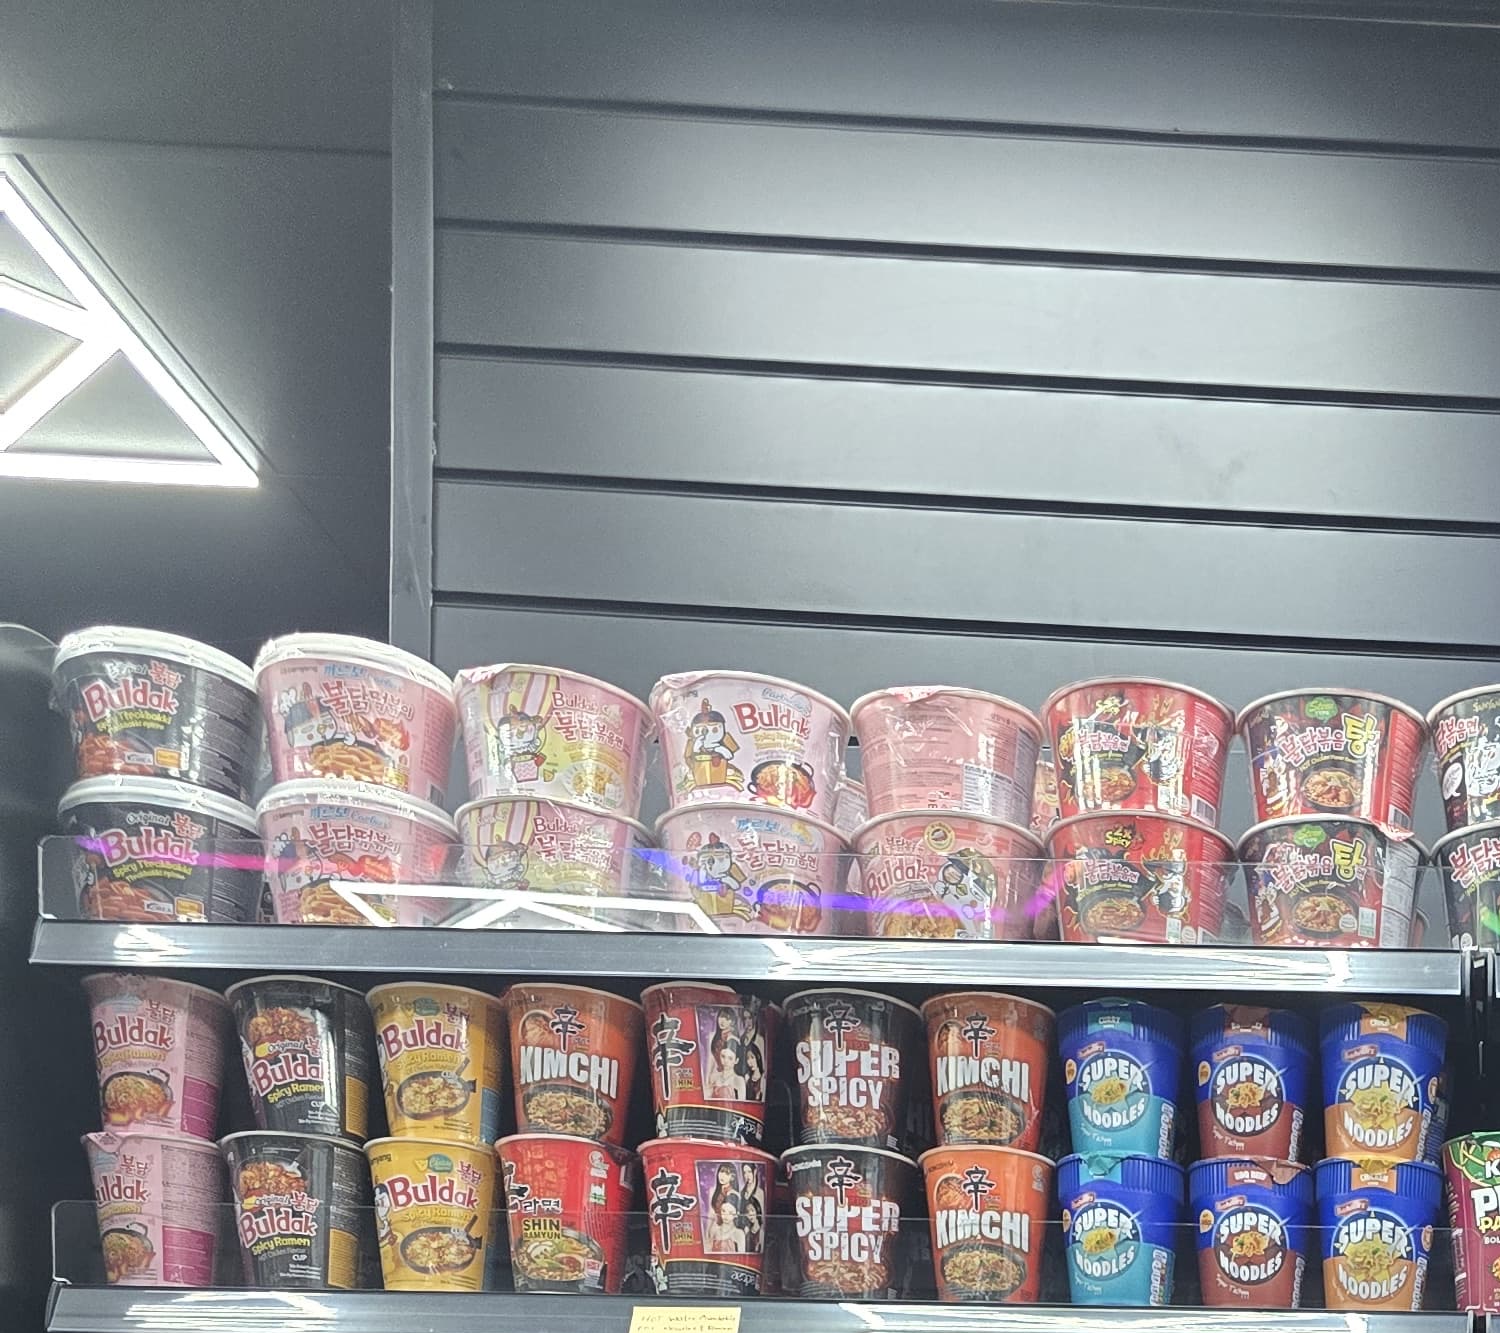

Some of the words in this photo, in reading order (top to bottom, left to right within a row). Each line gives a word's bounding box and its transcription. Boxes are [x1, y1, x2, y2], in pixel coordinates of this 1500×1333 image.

[81, 677, 178, 721] Buldak
[100, 827, 199, 866] Buldak
[797, 1040, 899, 1085] SUPER
[1215, 1062, 1279, 1092] SUPER
[807, 1078, 882, 1109] SPICY
[1215, 1103, 1279, 1133] NOODLES
[388, 1177, 478, 1209] Buldak
[241, 1212, 316, 1247] Buldak
[936, 1209, 1030, 1252] KIMCHI
